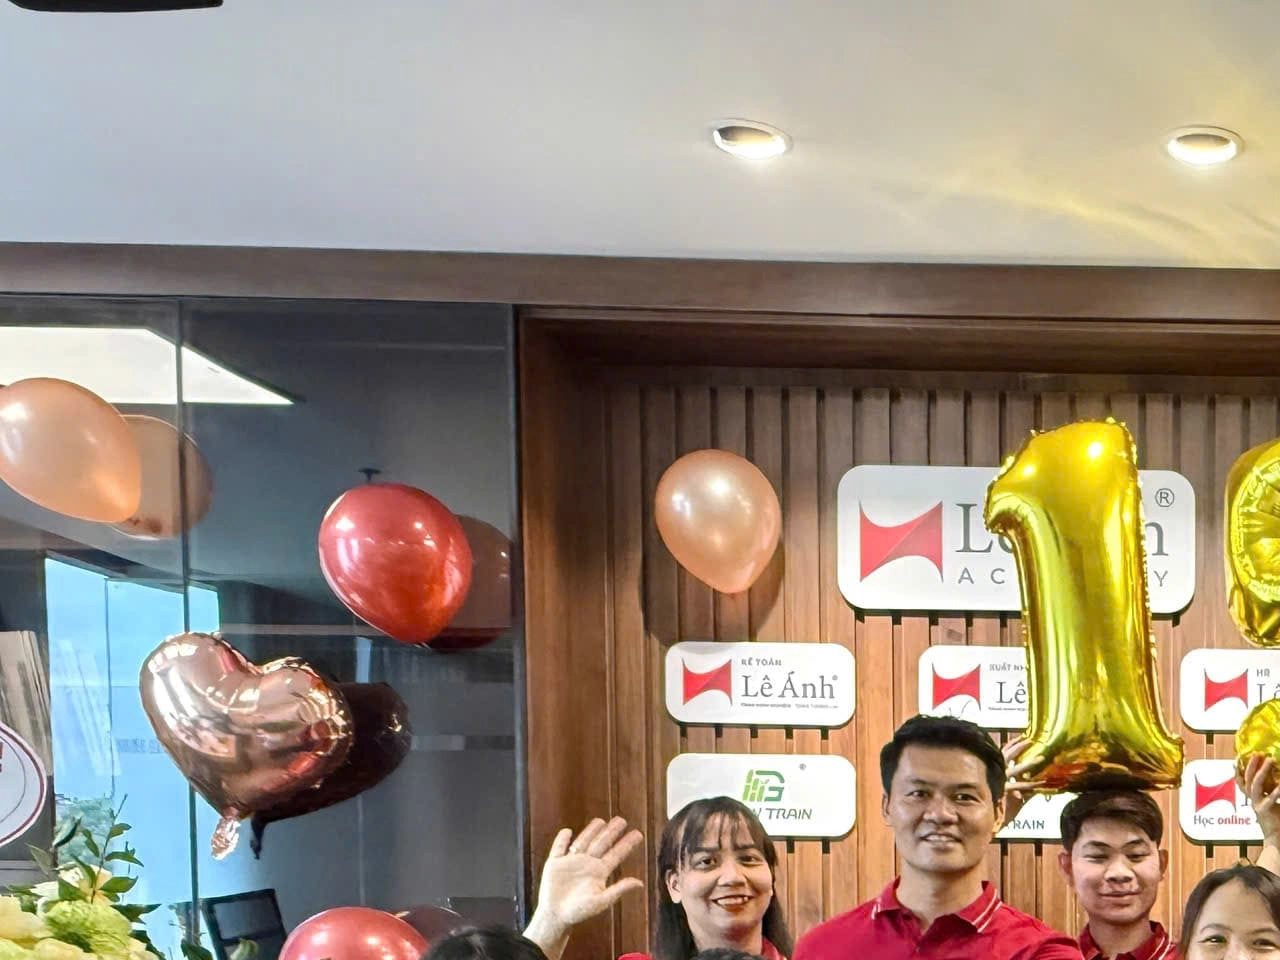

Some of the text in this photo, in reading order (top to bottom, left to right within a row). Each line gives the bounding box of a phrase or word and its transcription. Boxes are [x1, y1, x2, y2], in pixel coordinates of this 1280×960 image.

[1256, 668, 1270, 677] HR
[741, 674, 774, 698] Lê
[995, 681, 1027, 704] Lê
[766, 807, 813, 820] TRAIN
[1012, 819, 1046, 831] RAIN
[1193, 815, 1215, 828] Học
[1217, 815, 1252, 826] online
